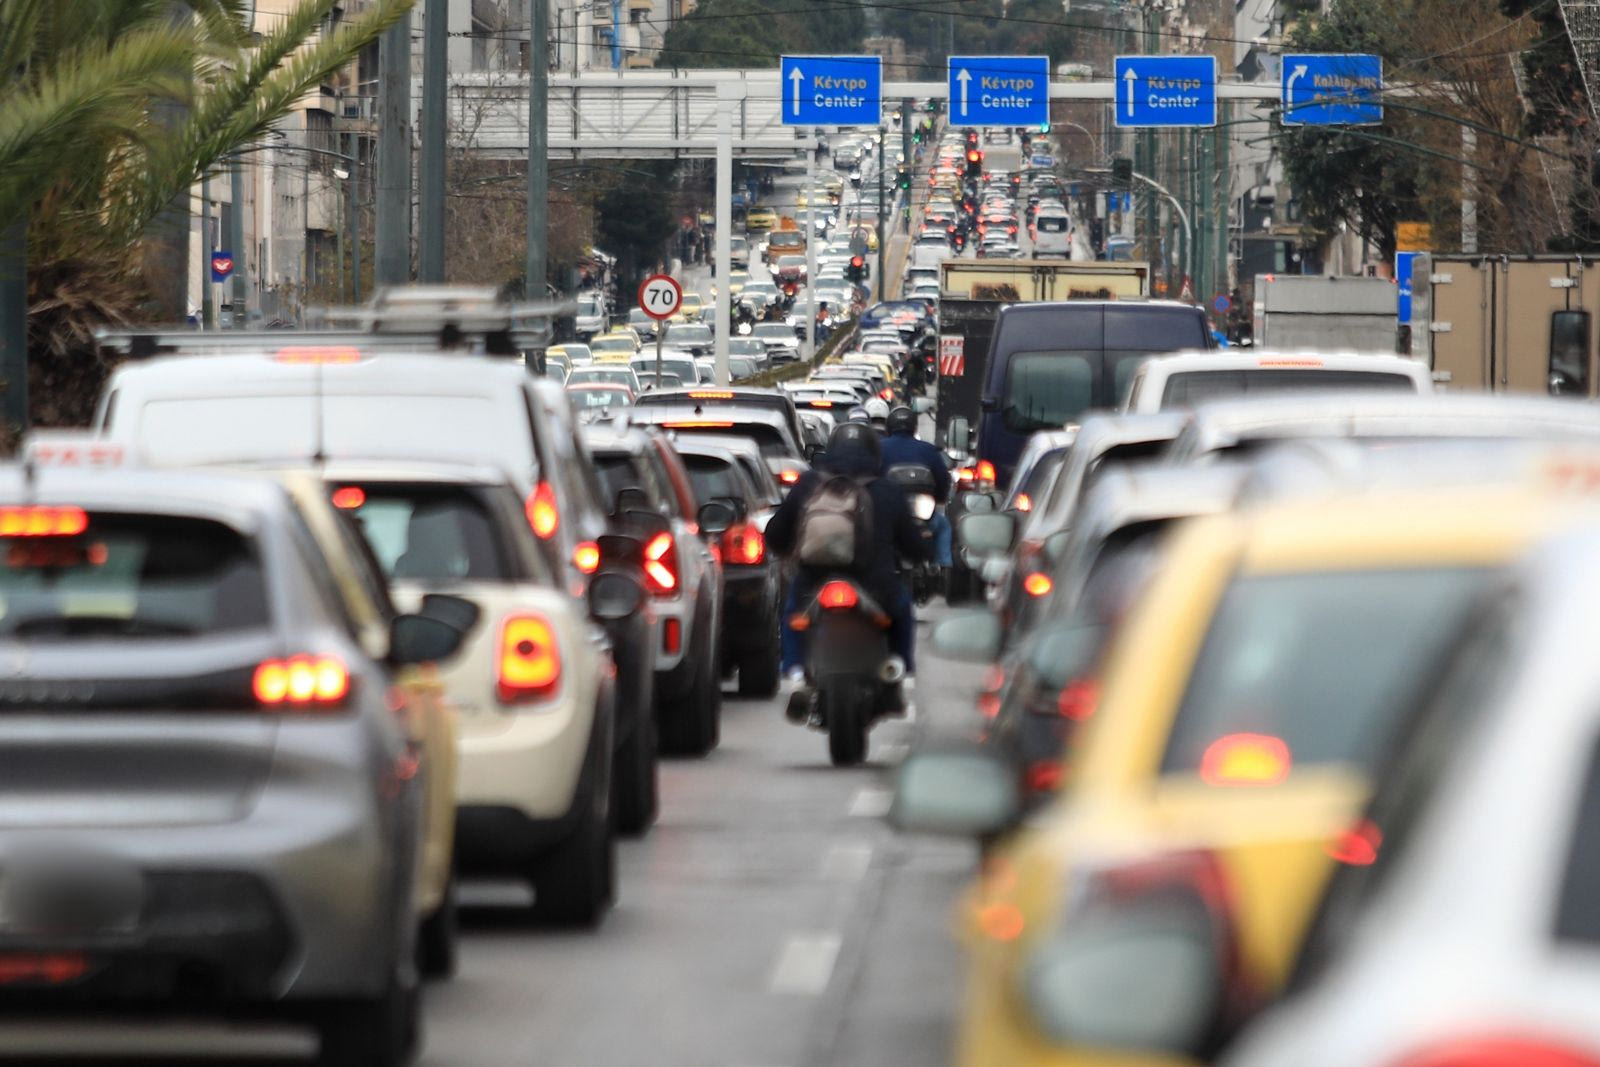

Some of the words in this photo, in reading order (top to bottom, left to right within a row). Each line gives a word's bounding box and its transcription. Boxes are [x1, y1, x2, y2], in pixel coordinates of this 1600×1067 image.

[814, 75, 867, 91] Κέντρο
[981, 75, 1034, 91] Κέντρο
[1148, 75, 1200, 92] Κέντρο
[814, 94, 865, 108] Center
[981, 94, 1032, 108] Center
[1148, 94, 1199, 108] Center
[649, 289, 673, 305] 70
